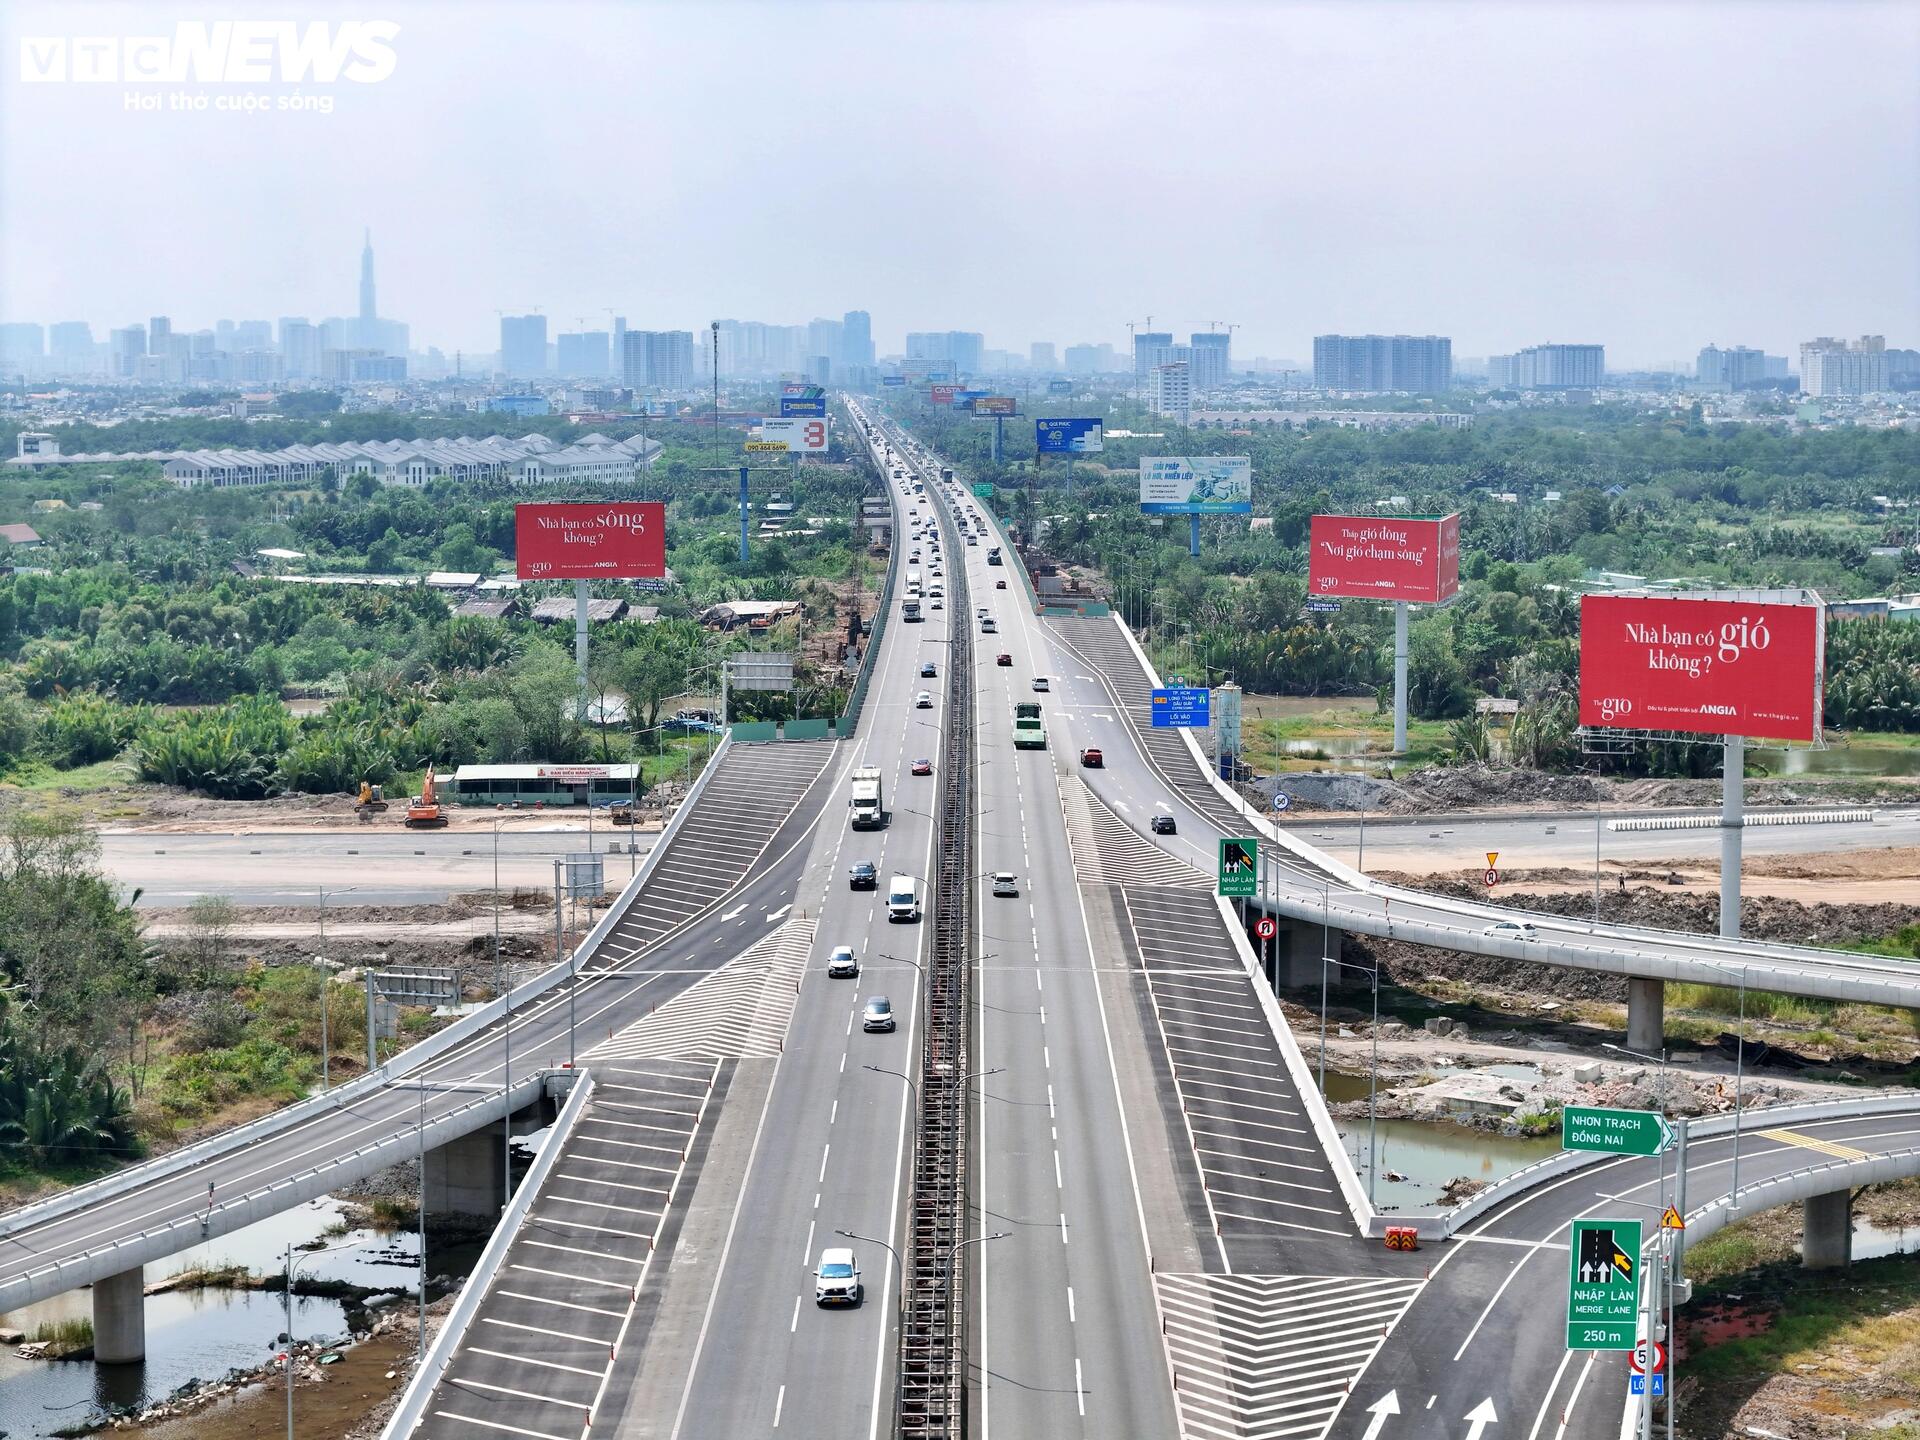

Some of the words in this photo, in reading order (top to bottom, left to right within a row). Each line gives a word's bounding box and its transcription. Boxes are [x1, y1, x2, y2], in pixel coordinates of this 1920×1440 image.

[537, 518, 559, 529] Nhà
[562, 517, 579, 530] bạn
[582, 518, 594, 528] có
[596, 510, 644, 536] sông
[1360, 528, 1377, 544] gió
[1346, 545, 1363, 561] gió
[1365, 544, 1394, 560] chạm
[1624, 624, 1658, 644] Nhà
[1663, 624, 1691, 648] bạn
[1696, 630, 1714, 646] có
[1718, 616, 1770, 663] gió
[1649, 650, 1700, 678] không
[1700, 704, 1737, 716] ANGIA
[1572, 1116, 1600, 1127] NHƠN
[1604, 1118, 1640, 1131] TRẠCH
[1604, 1135, 1623, 1145] NAI
[1574, 1288, 1605, 1303] NHẬP
[1611, 1288, 1634, 1301] LÀN
[1576, 1306, 1603, 1314] MERGE
[1608, 1306, 1631, 1314] LANE
[1584, 1330, 1606, 1342] 250
[1609, 1333, 1621, 1342] m
